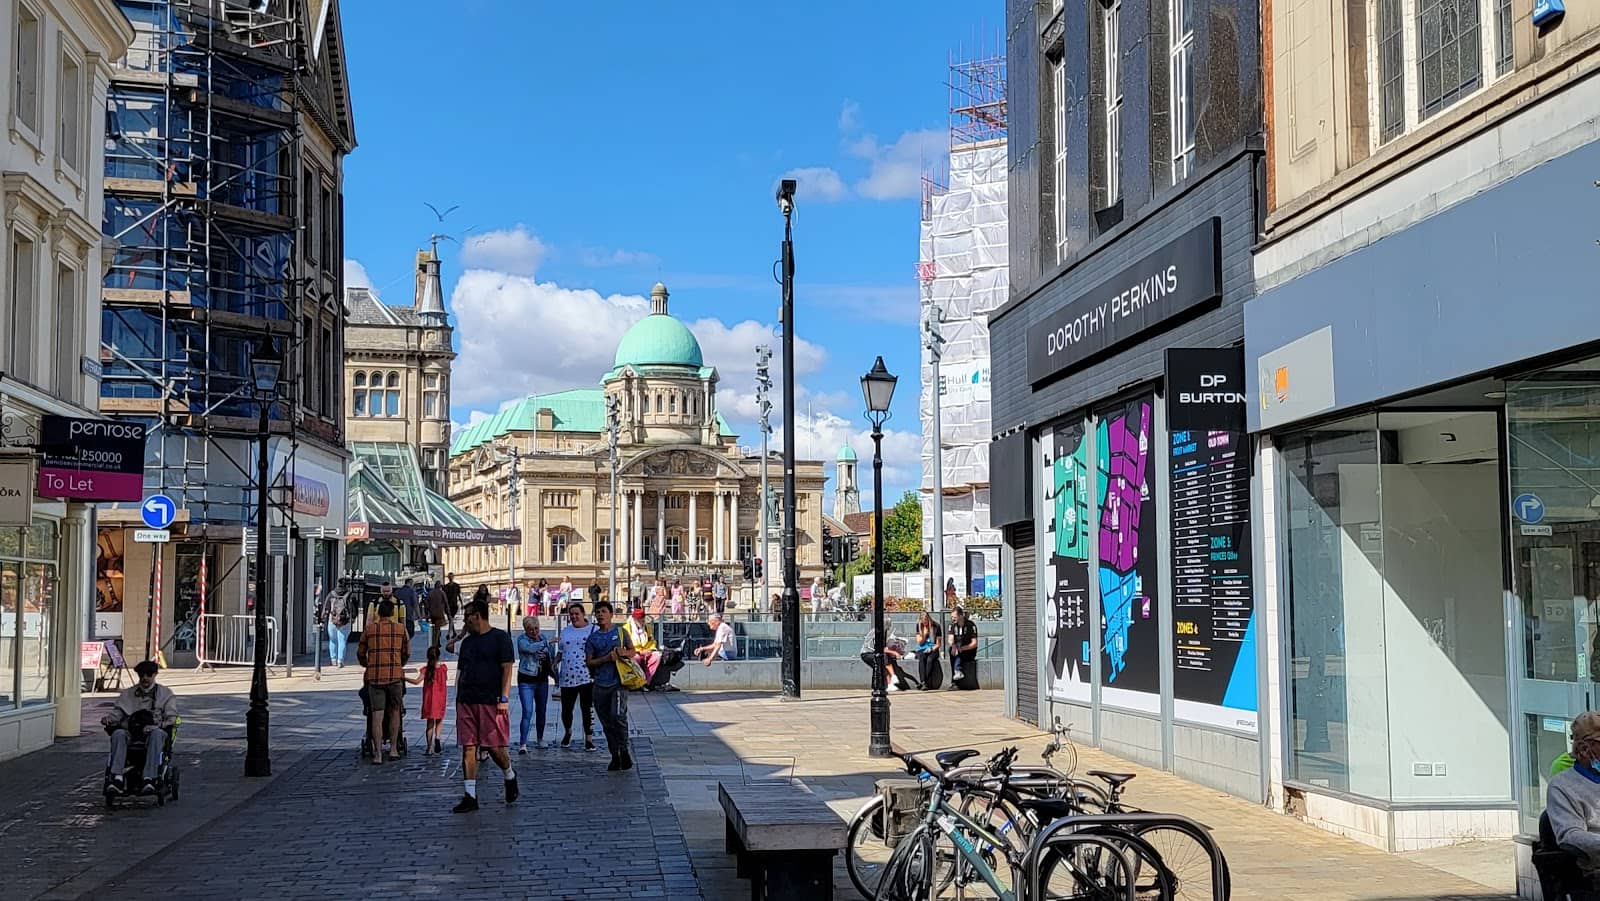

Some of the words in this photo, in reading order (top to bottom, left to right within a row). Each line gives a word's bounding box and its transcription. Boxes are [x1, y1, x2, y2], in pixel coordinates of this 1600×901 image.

[1048, 302, 1108, 356] DOROTHY
[1111, 265, 1178, 323] PERKINS
[1200, 375, 1226, 387] DP
[1179, 393, 1247, 404] BURTON
[70, 421, 143, 440] penrose
[45, 474, 64, 490] To
[69, 475, 94, 491] Let
[1210, 536, 1226, 549] ZONE
